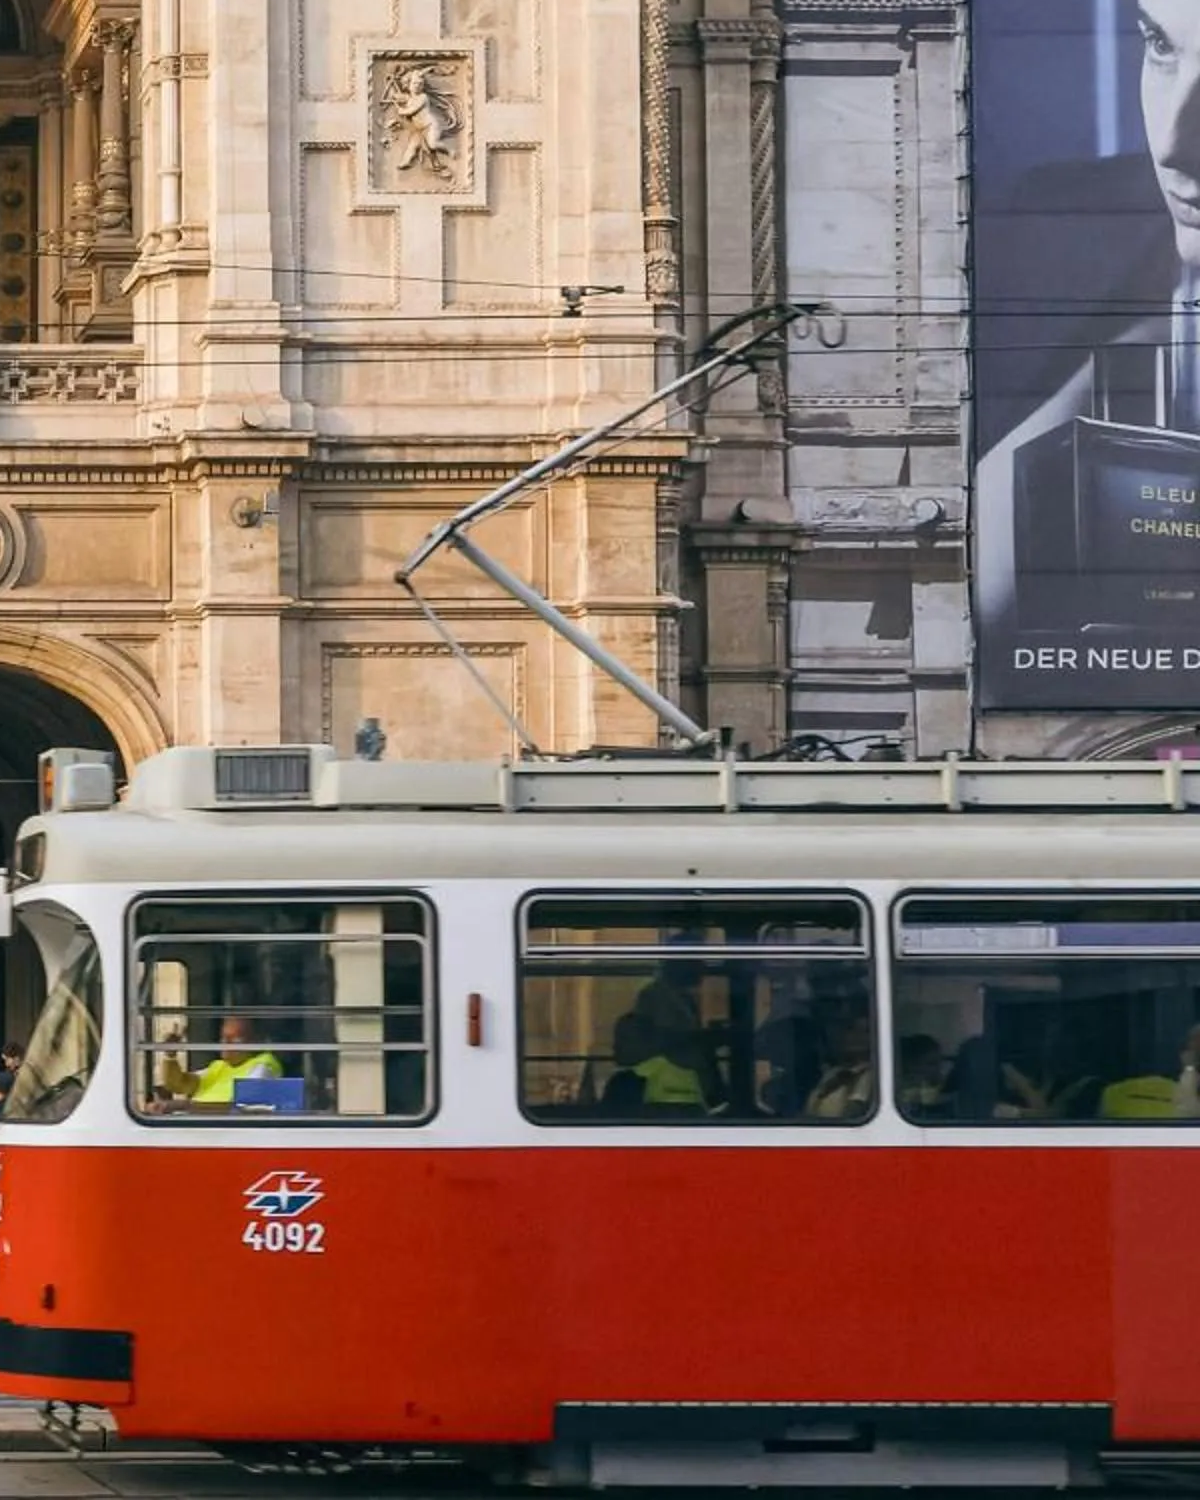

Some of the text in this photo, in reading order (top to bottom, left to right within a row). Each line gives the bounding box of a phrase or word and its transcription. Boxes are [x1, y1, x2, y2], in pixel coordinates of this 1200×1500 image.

[1141, 485, 1195, 503] BLEU
[1014, 647, 1078, 669] DER
[1087, 648, 1173, 670] NEUE
[242, 1221, 326, 1253] 4092
